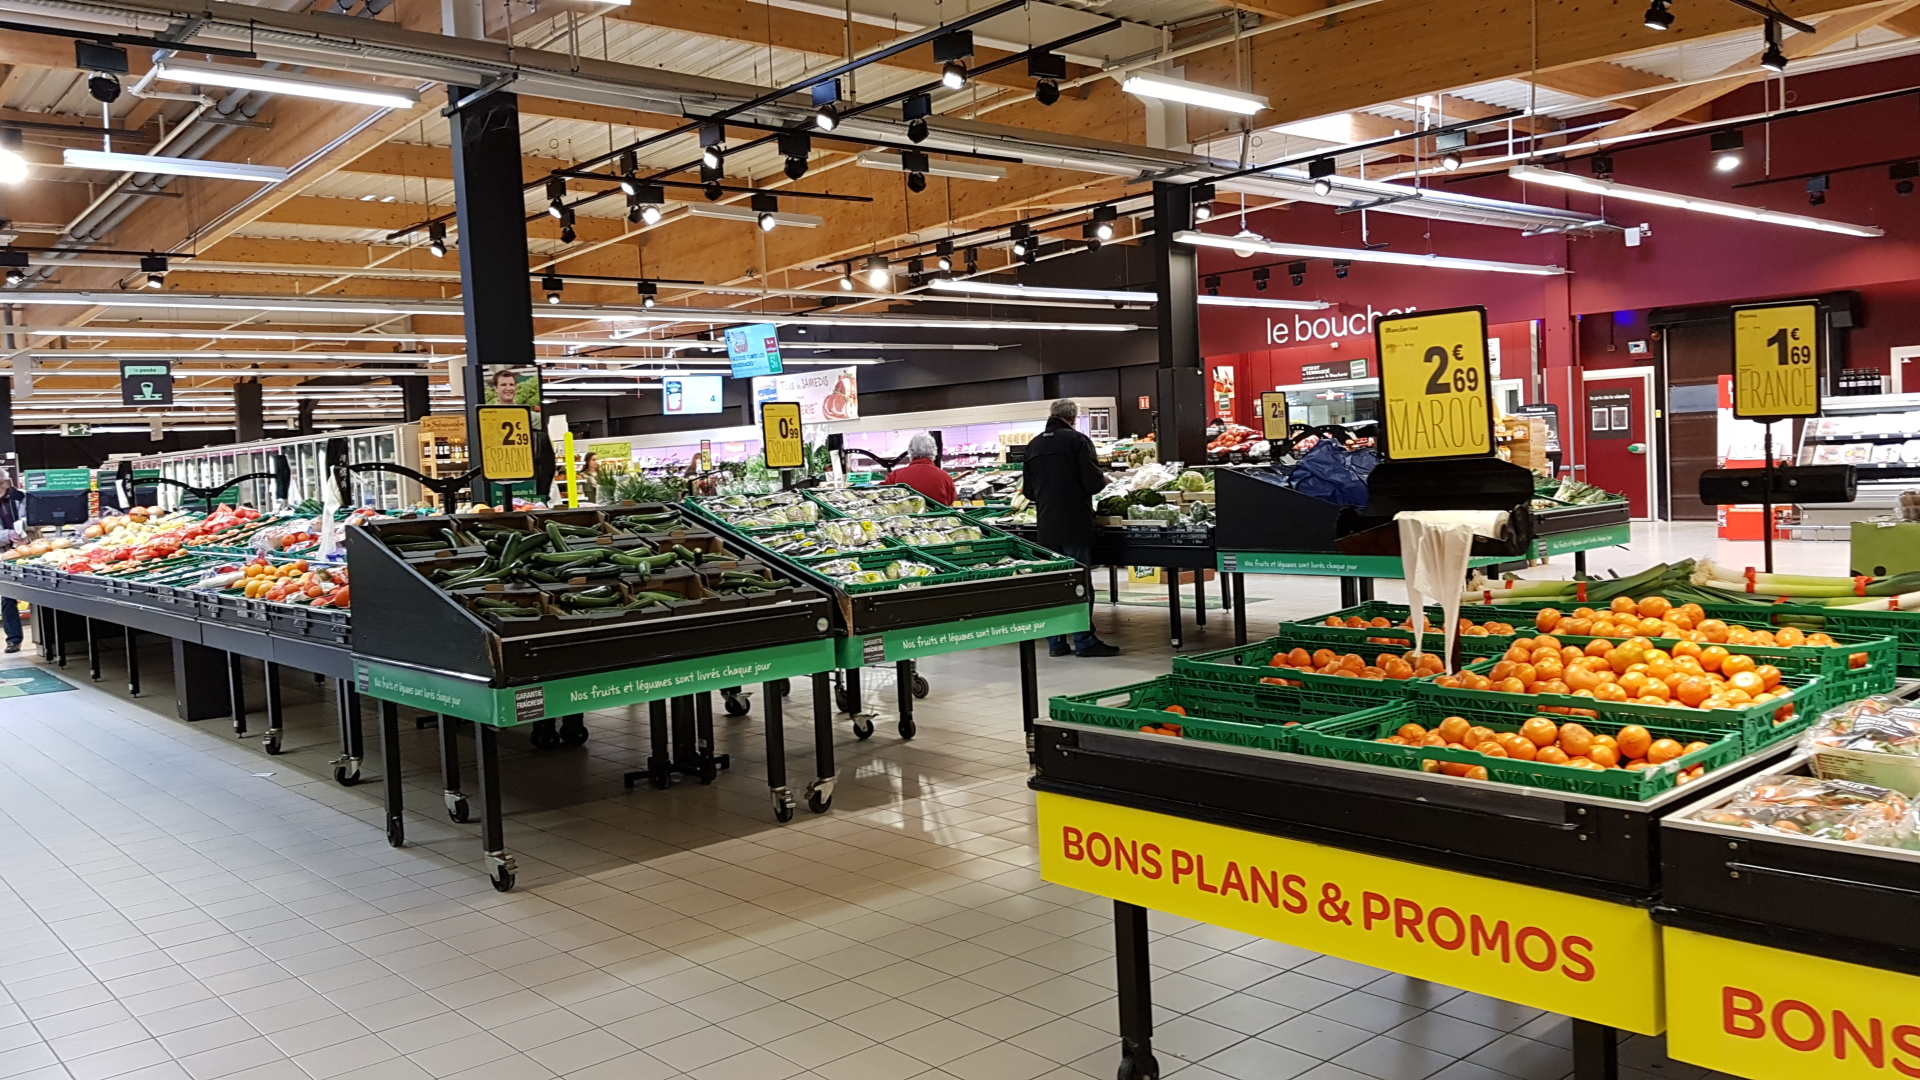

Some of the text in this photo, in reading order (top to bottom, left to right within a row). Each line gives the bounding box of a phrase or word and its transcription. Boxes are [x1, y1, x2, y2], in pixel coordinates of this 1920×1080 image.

[1267, 318, 1289, 344] le
[801, 376, 828, 389] SAMEDIS
[1740, 368, 1813, 409] FRANCE
[1389, 396, 1483, 451] MAROC
[485, 446, 532, 474] ESPAGNE
[768, 441, 801, 463] ESPAGNE
[1254, 559, 1269, 567] fruits
[1326, 561, 1345, 571] chaque
[1346, 563, 1358, 572] jour
[903, 620, 1046, 649] Nos fruits et légumes sont livrés chaque jour
[516, 689, 543, 700] GARANTIE
[571, 662, 771, 701] Nos fruits et légumes sont livrés chaque jour
[516, 698, 543, 709] FRAÎCHEUR
[1063, 826, 1595, 982] BONS PLANS & PROMOS
[1723, 986, 1920, 1079] BONS
